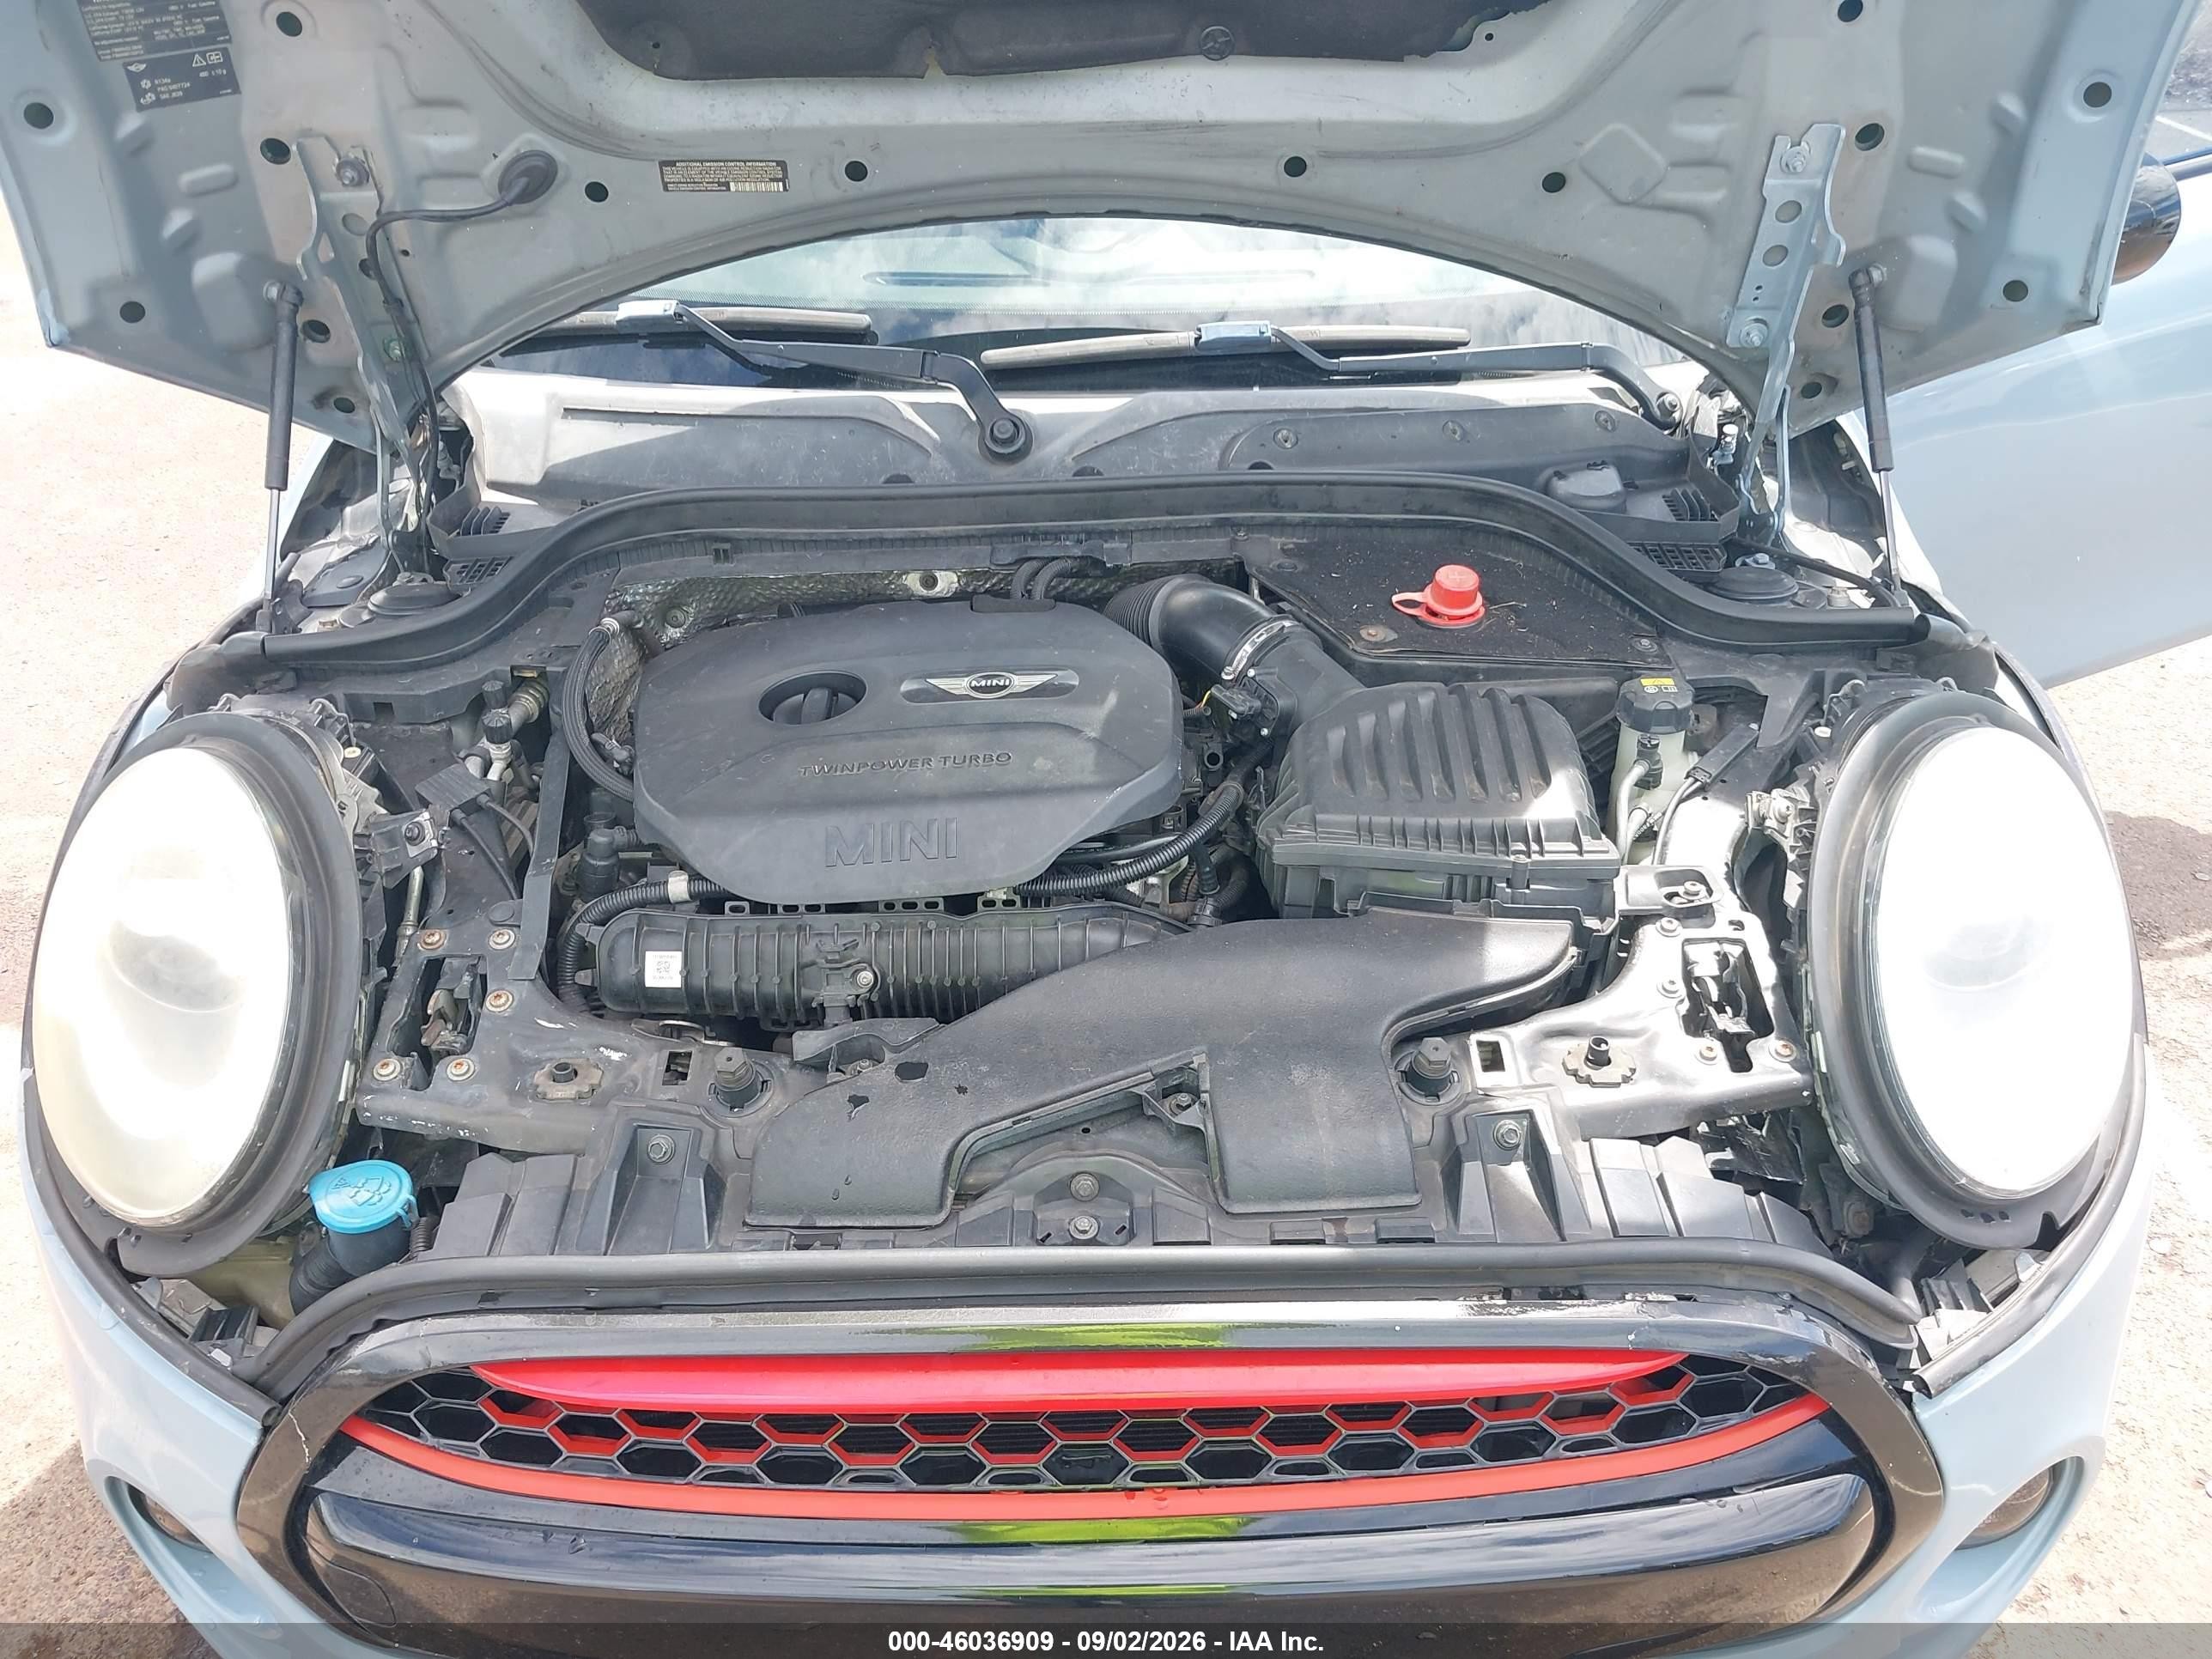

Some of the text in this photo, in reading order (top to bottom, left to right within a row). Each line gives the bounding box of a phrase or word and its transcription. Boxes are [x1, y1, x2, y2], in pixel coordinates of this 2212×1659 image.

[970, 678, 1011, 688] MINI
[799, 752, 1012, 776] TWINPOWER TURBO
[825, 817, 957, 868] MINI
